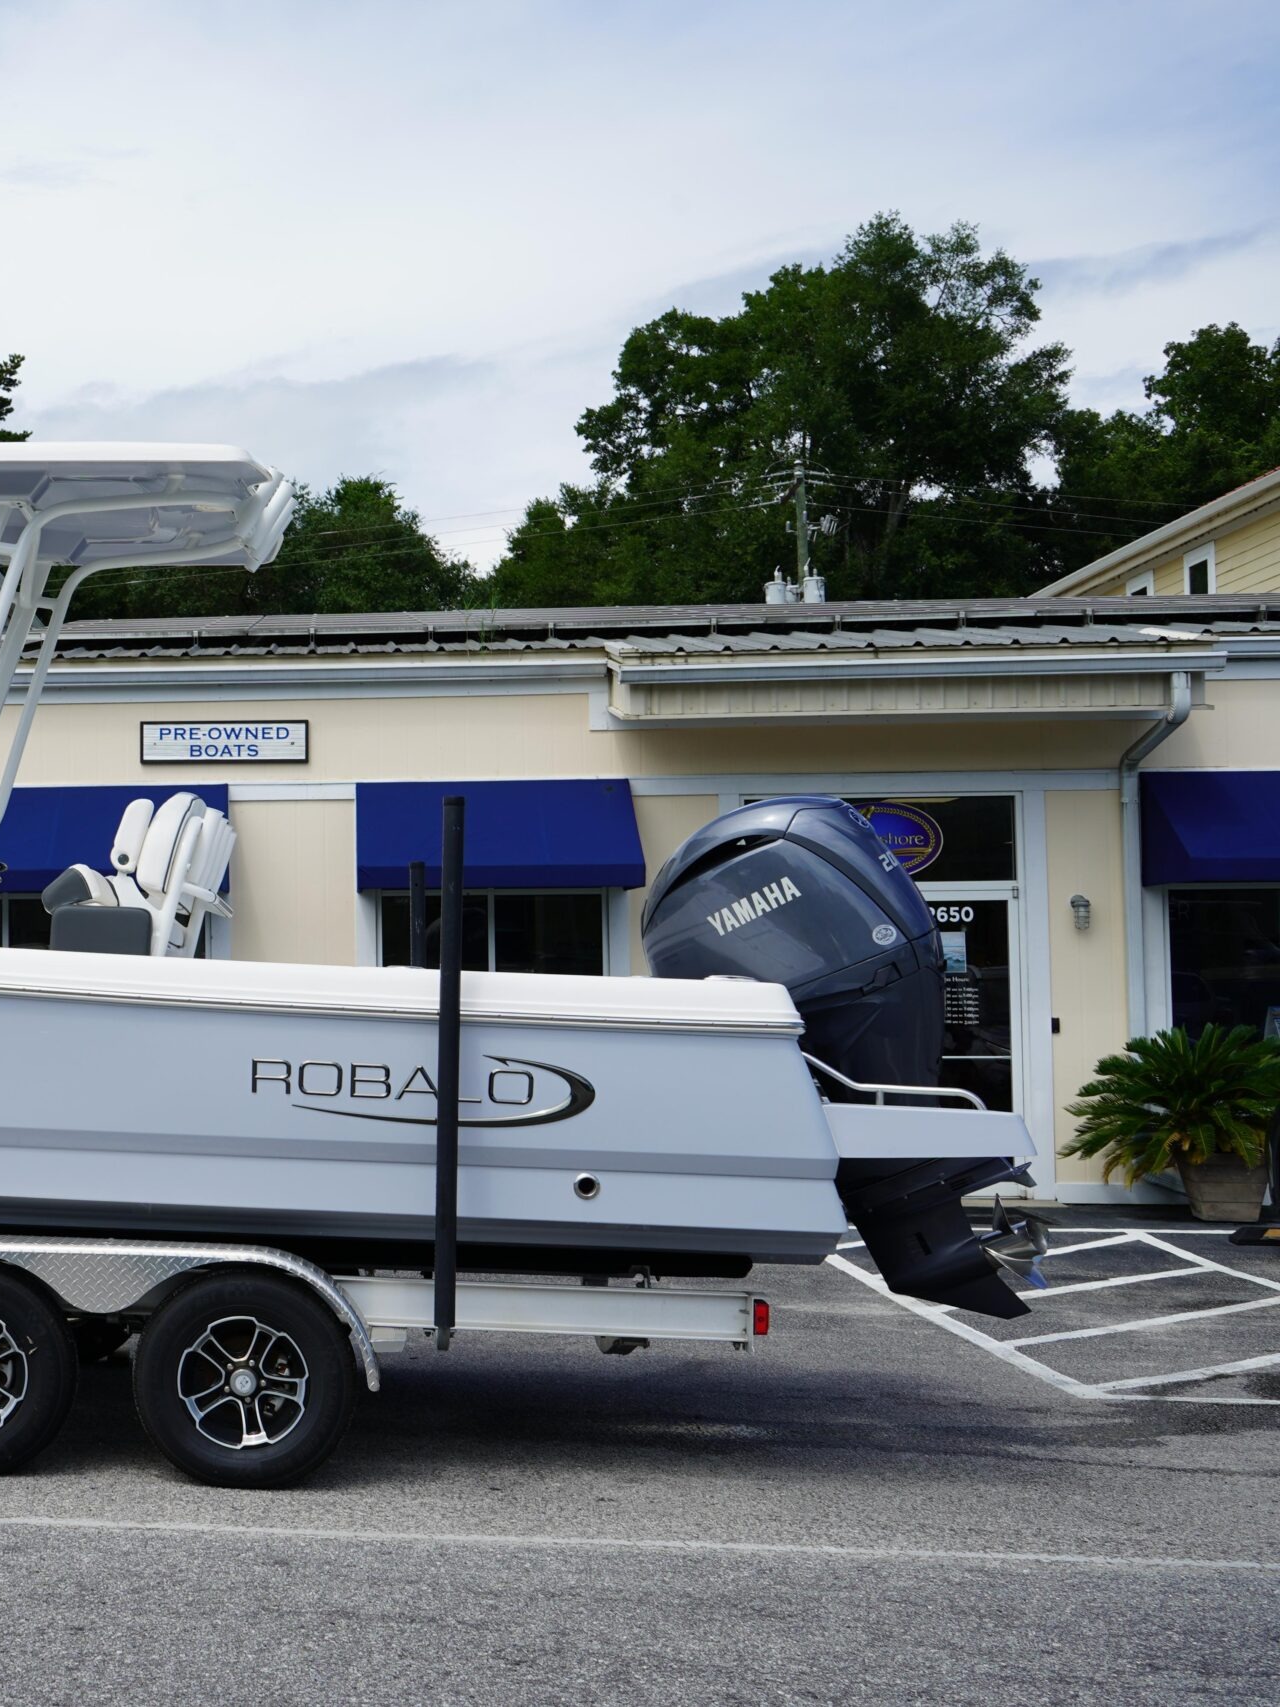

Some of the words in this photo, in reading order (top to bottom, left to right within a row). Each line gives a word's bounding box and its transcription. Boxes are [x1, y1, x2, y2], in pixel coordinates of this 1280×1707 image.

[159, 727, 290, 741] PRE-OWNED
[189, 744, 259, 758] BOATS
[706, 876, 802, 937] YAMAHA
[251, 1057, 534, 1105] ROBAO
